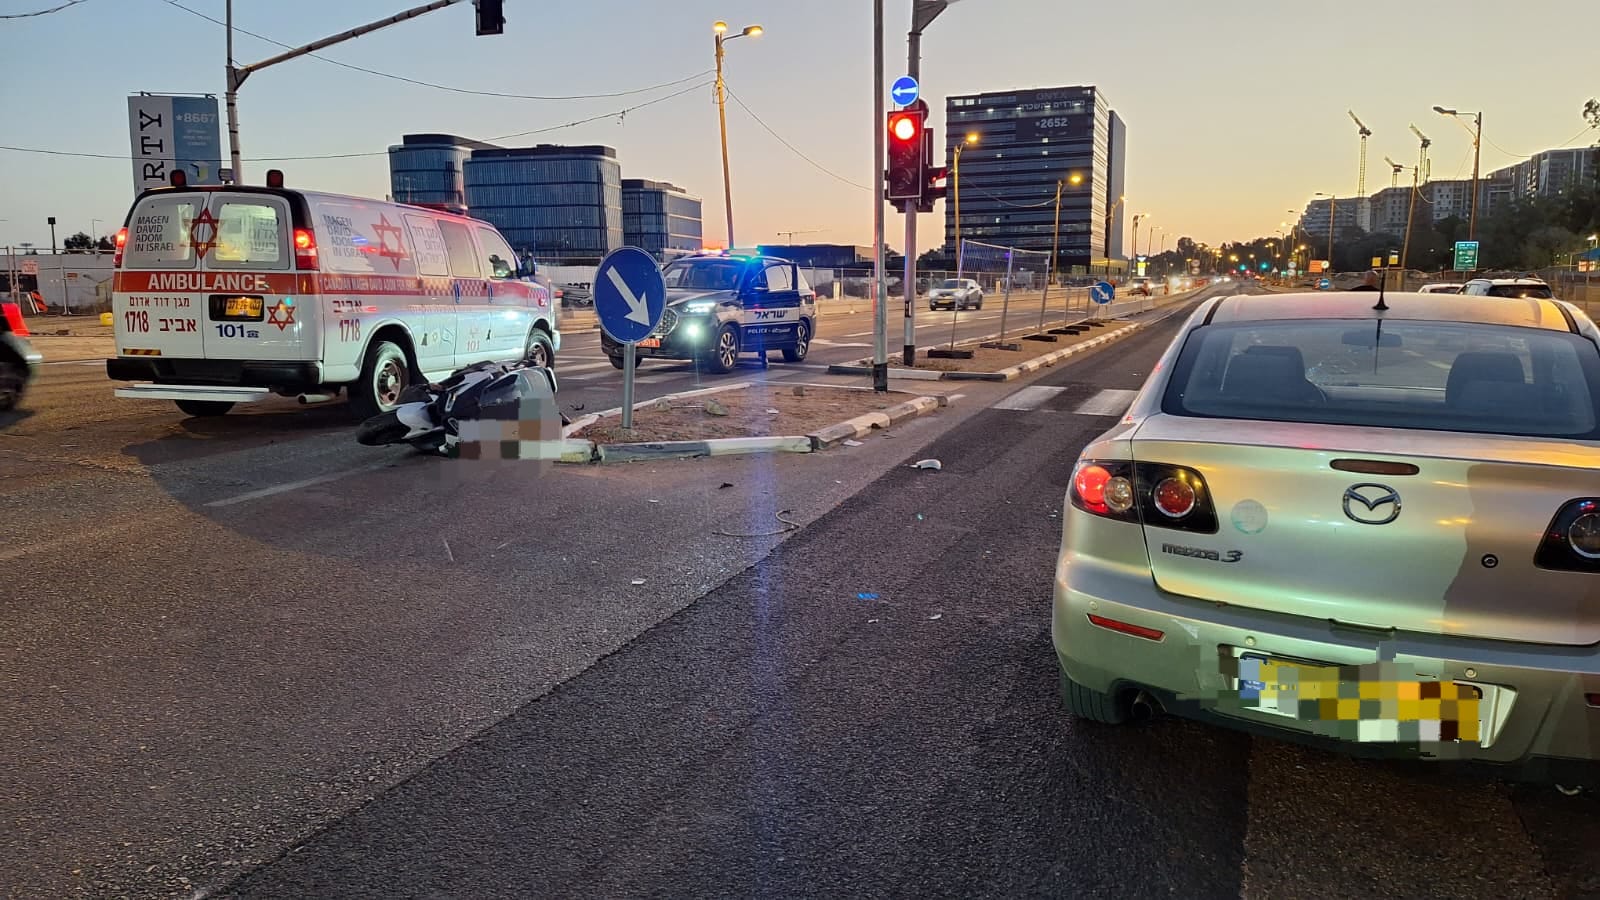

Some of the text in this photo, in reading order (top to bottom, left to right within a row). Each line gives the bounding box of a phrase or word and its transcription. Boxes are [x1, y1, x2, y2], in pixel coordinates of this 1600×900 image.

[138, 108, 166, 191] RTY
[137, 215, 169, 225] MAGEN
[136, 224, 164, 234] DAVID
[135, 233, 163, 243] ADOM
[134, 242, 175, 252] IN ISRAEL
[148, 273, 267, 291] AMBULANCE
[129, 296, 190, 309] מגן דוד אדום
[124, 310, 150, 332] 1718
[754, 310, 788, 319] ישראל
[159, 318, 197, 332] אביב
[215, 324, 246, 338] 101
[339, 318, 361, 342] 1718
